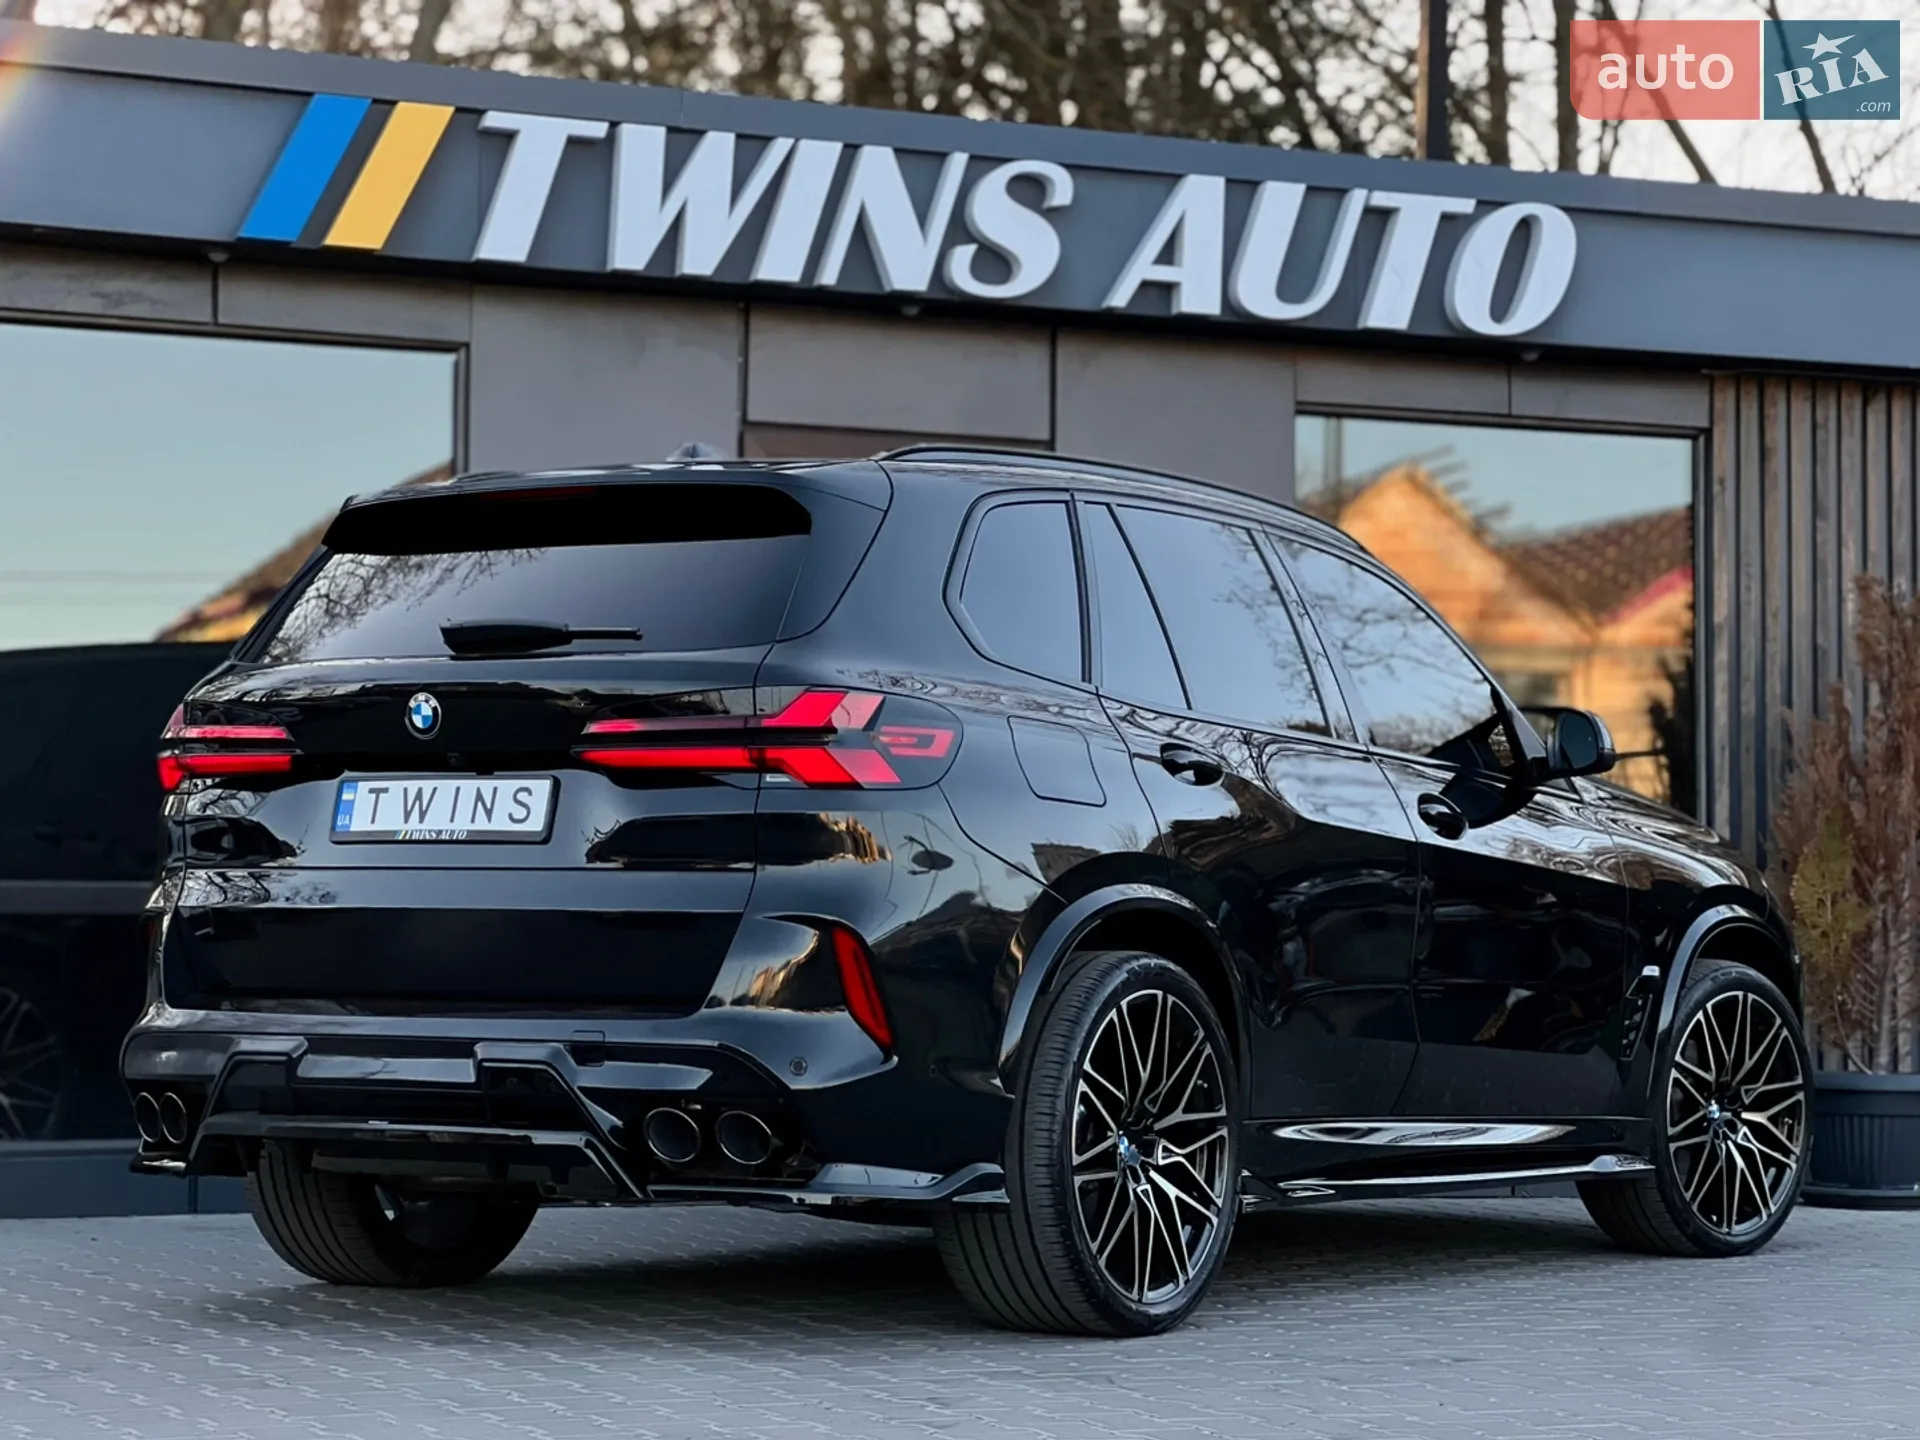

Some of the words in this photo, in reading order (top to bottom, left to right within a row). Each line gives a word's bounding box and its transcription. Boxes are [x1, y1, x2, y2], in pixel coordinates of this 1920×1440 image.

[472, 110, 1074, 299] TWINS
[1101, 173, 1578, 337] AUTO
[367, 785, 533, 825] TWINS
[337, 814, 350, 825] UA
[405, 829, 438, 840] TWINS
[438, 829, 468, 840] AUTO
